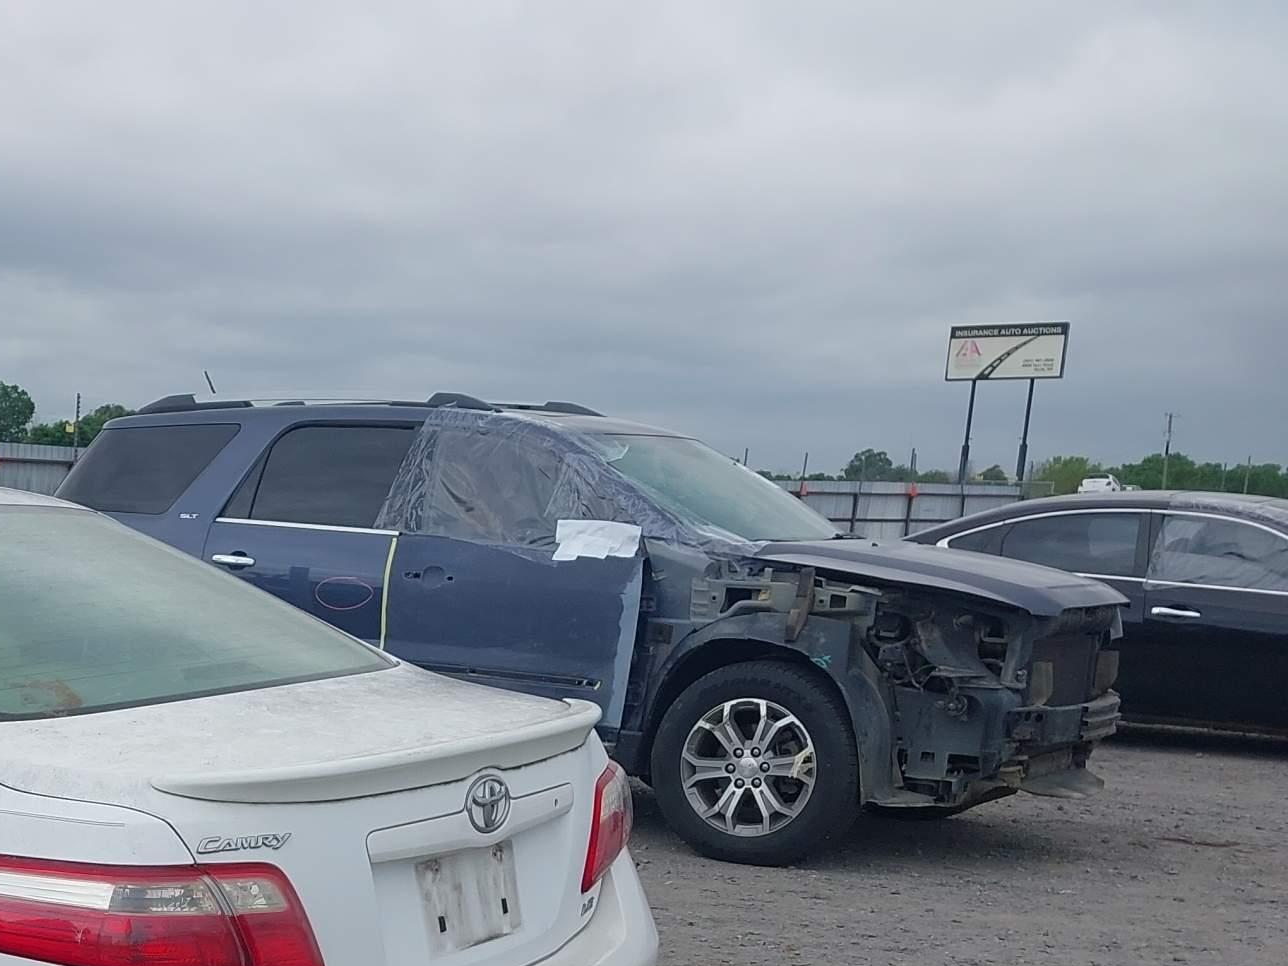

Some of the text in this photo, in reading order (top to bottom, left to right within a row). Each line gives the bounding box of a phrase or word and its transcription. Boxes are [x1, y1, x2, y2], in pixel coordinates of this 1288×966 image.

[955, 328, 999, 337] INSURANCE
[1022, 326, 1062, 334] AUCTIONS
[196, 832, 292, 855] CAMRY
